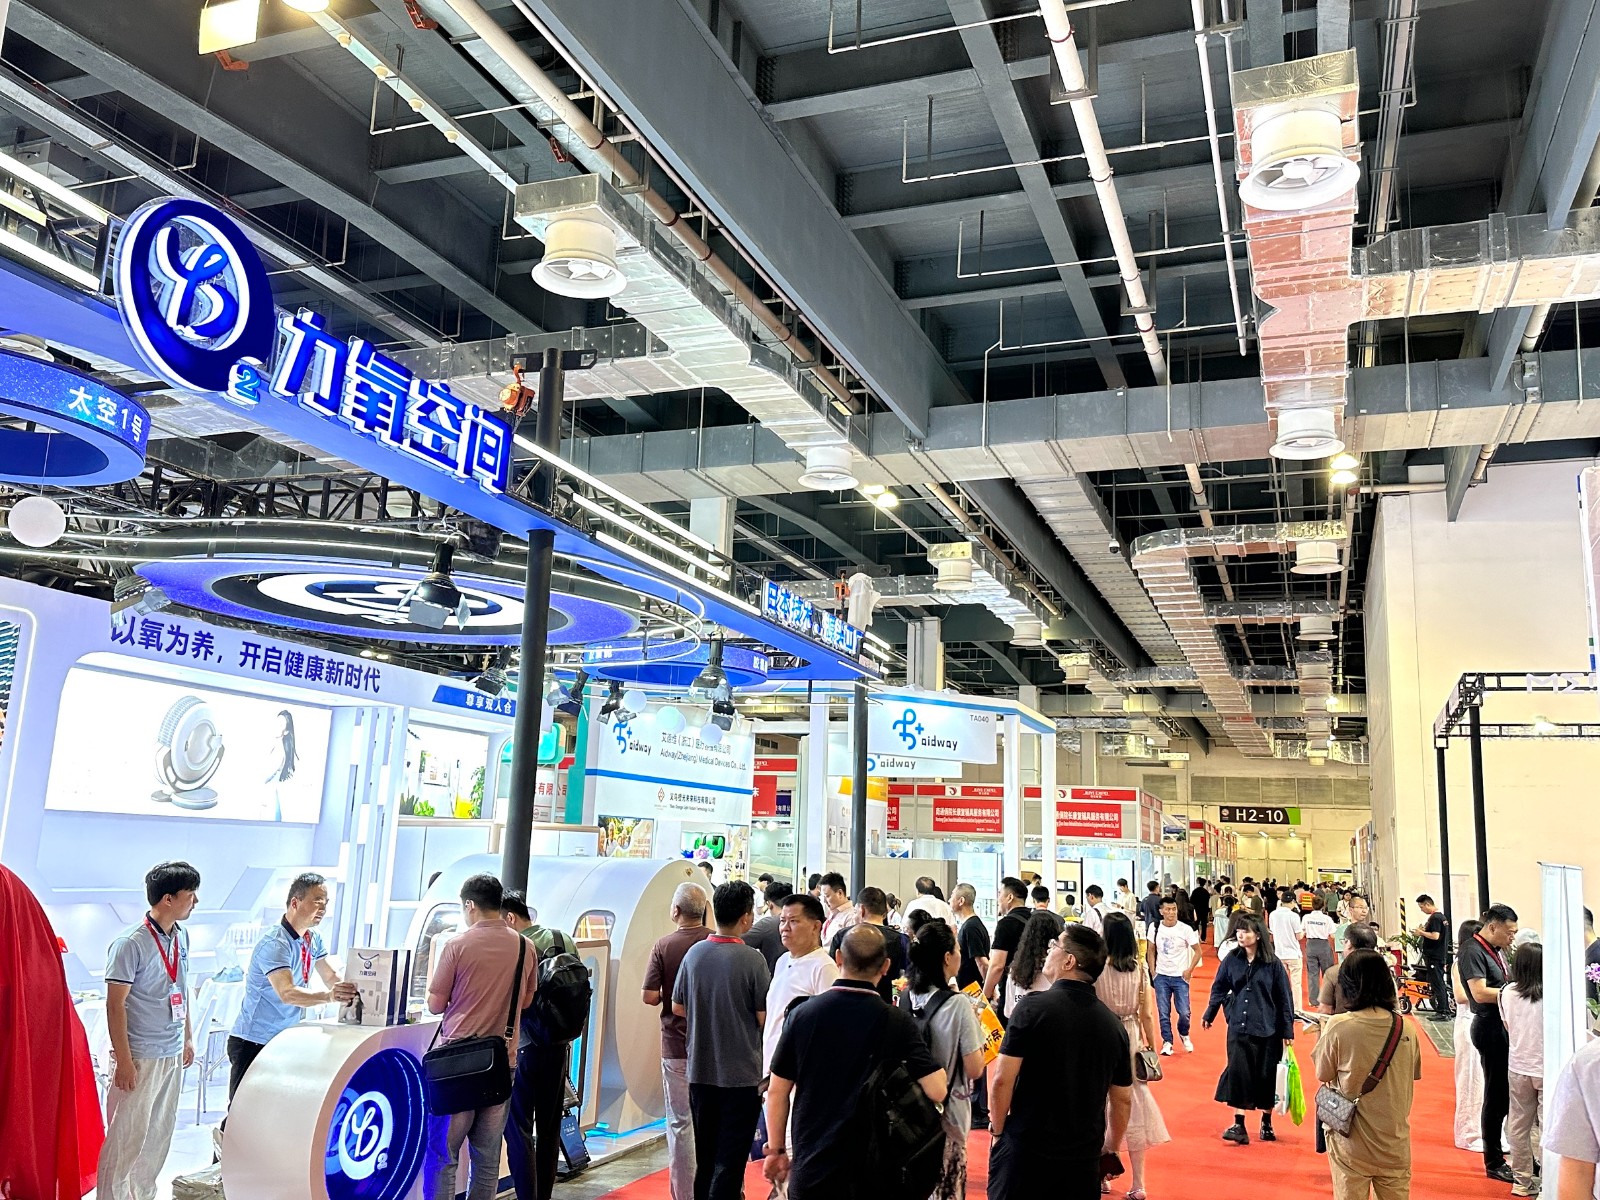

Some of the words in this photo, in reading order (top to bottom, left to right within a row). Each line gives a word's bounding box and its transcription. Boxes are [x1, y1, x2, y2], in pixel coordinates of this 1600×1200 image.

[270, 308, 514, 496] 力氧空间
[67, 385, 143, 443] 太空1号
[628, 741, 652, 756] aidway
[921, 734, 958, 752] aidway
[879, 755, 917, 770] aidway
[1235, 808, 1284, 823] H2-10
